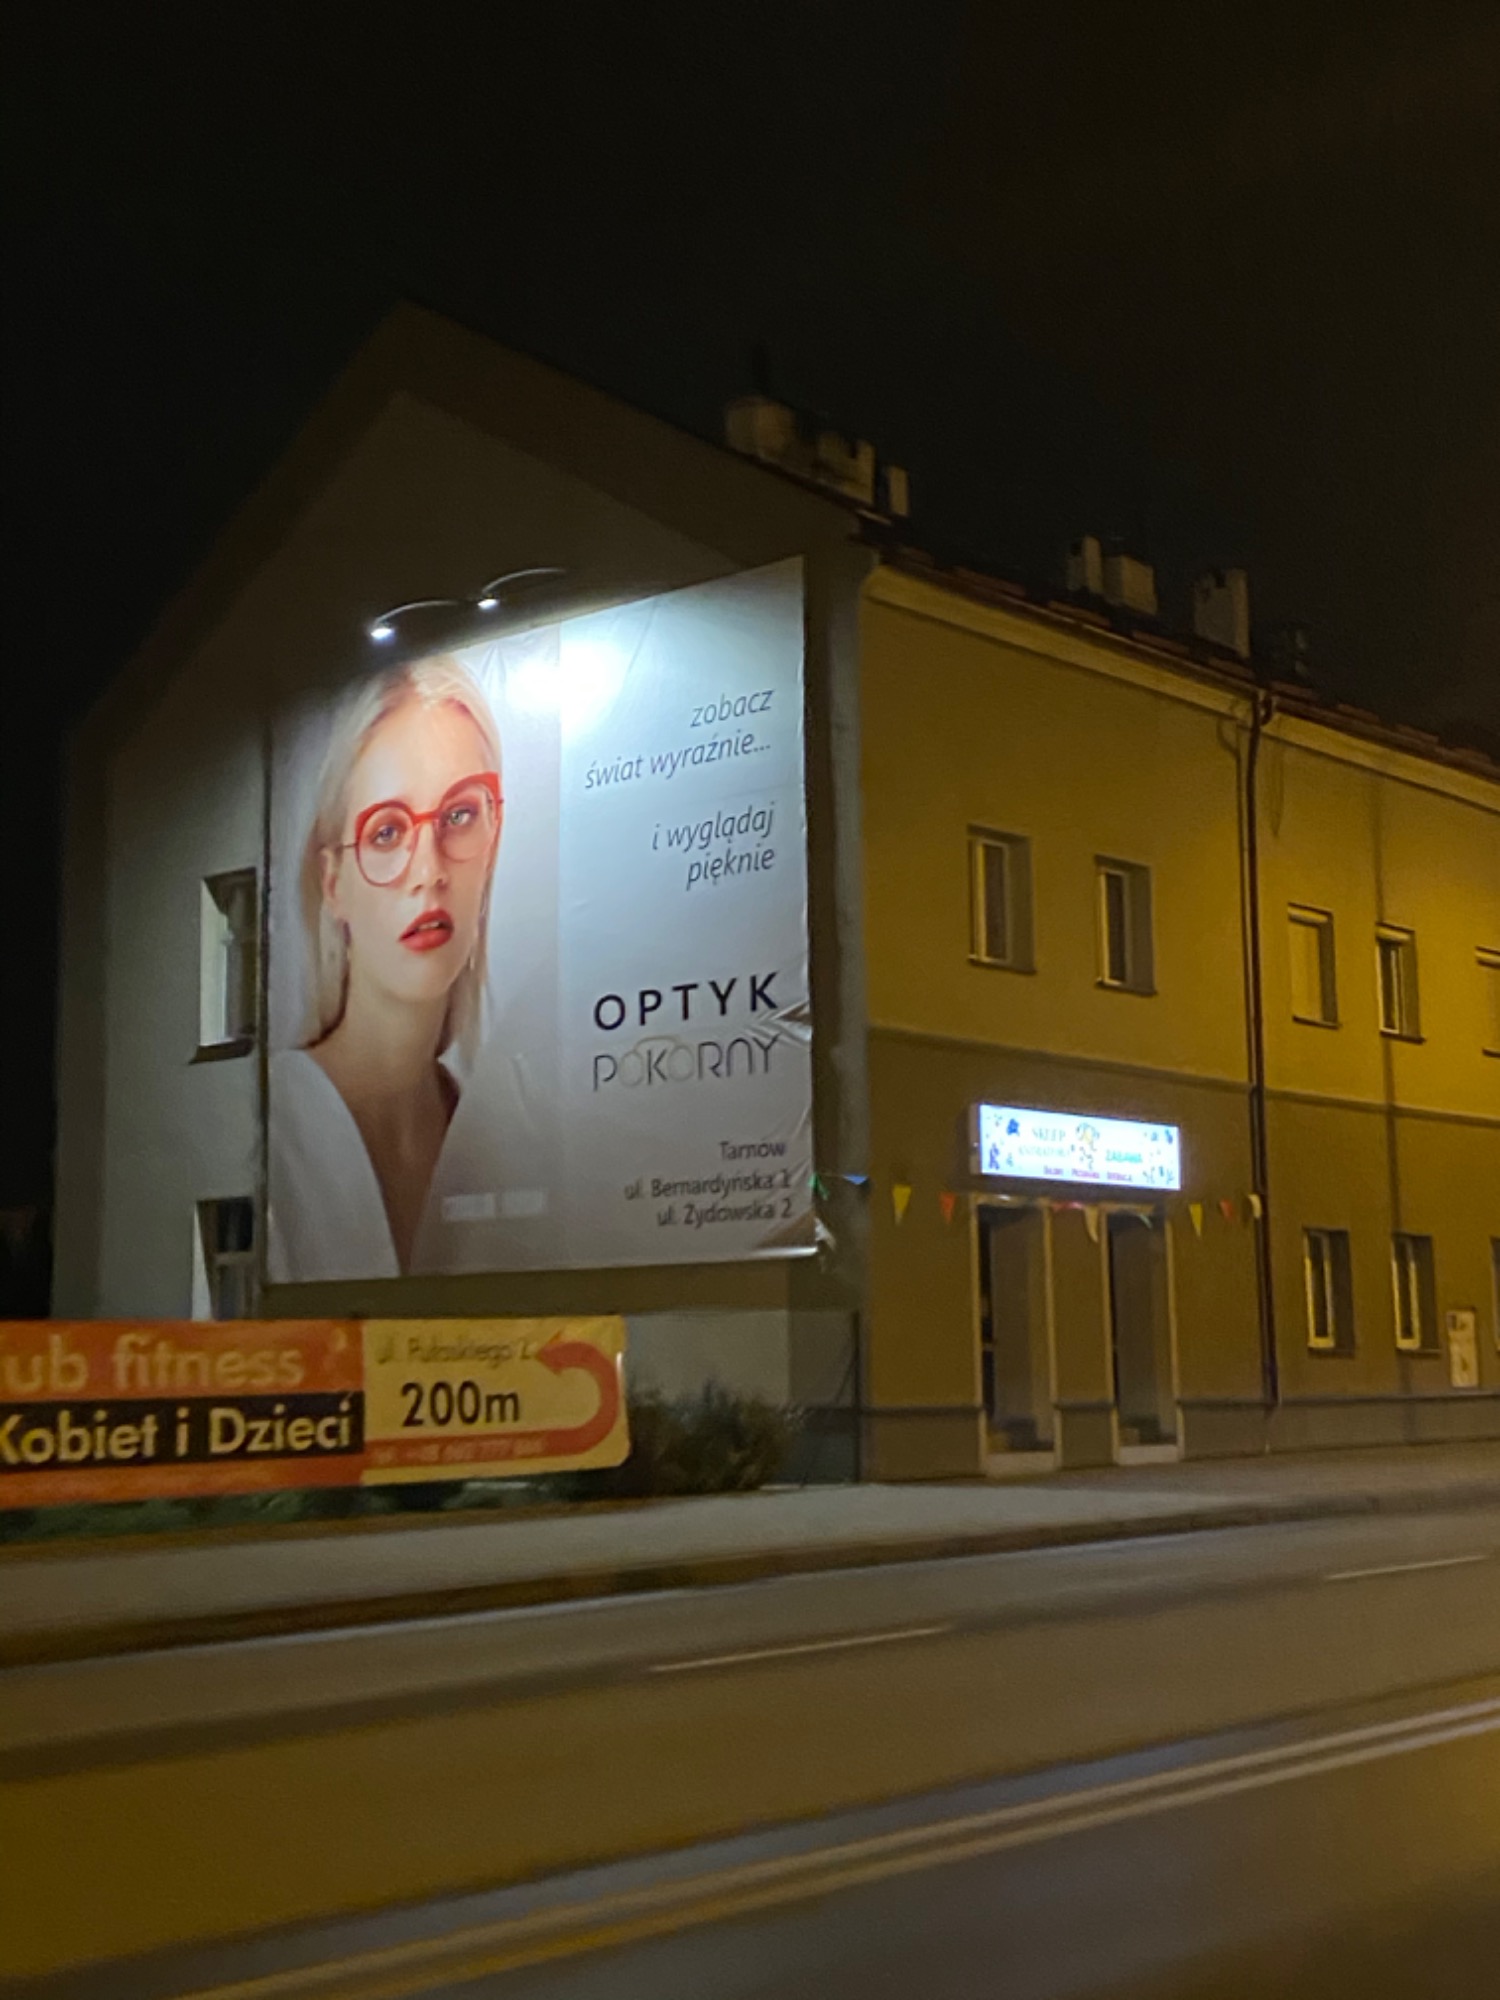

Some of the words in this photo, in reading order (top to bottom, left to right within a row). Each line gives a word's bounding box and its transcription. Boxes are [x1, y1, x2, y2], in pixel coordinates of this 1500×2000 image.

[690, 688, 775, 728] zobacz
[585, 754, 644, 789] świat
[652, 824, 661, 850] i
[667, 801, 775, 852] wyglądaj
[686, 842, 775, 891] pięknie
[593, 971, 779, 1031] OPTYK
[593, 1032, 782, 1092] POKORNY
[781, 1198, 793, 1218] 2
[0, 1333, 89, 1393] ub
[113, 1332, 305, 1391] fitness
[401, 1380, 520, 1427] 200m
[0, 1409, 158, 1464] Kobiet
[176, 1406, 190, 1457] i
[209, 1396, 353, 1454] Dzieci
